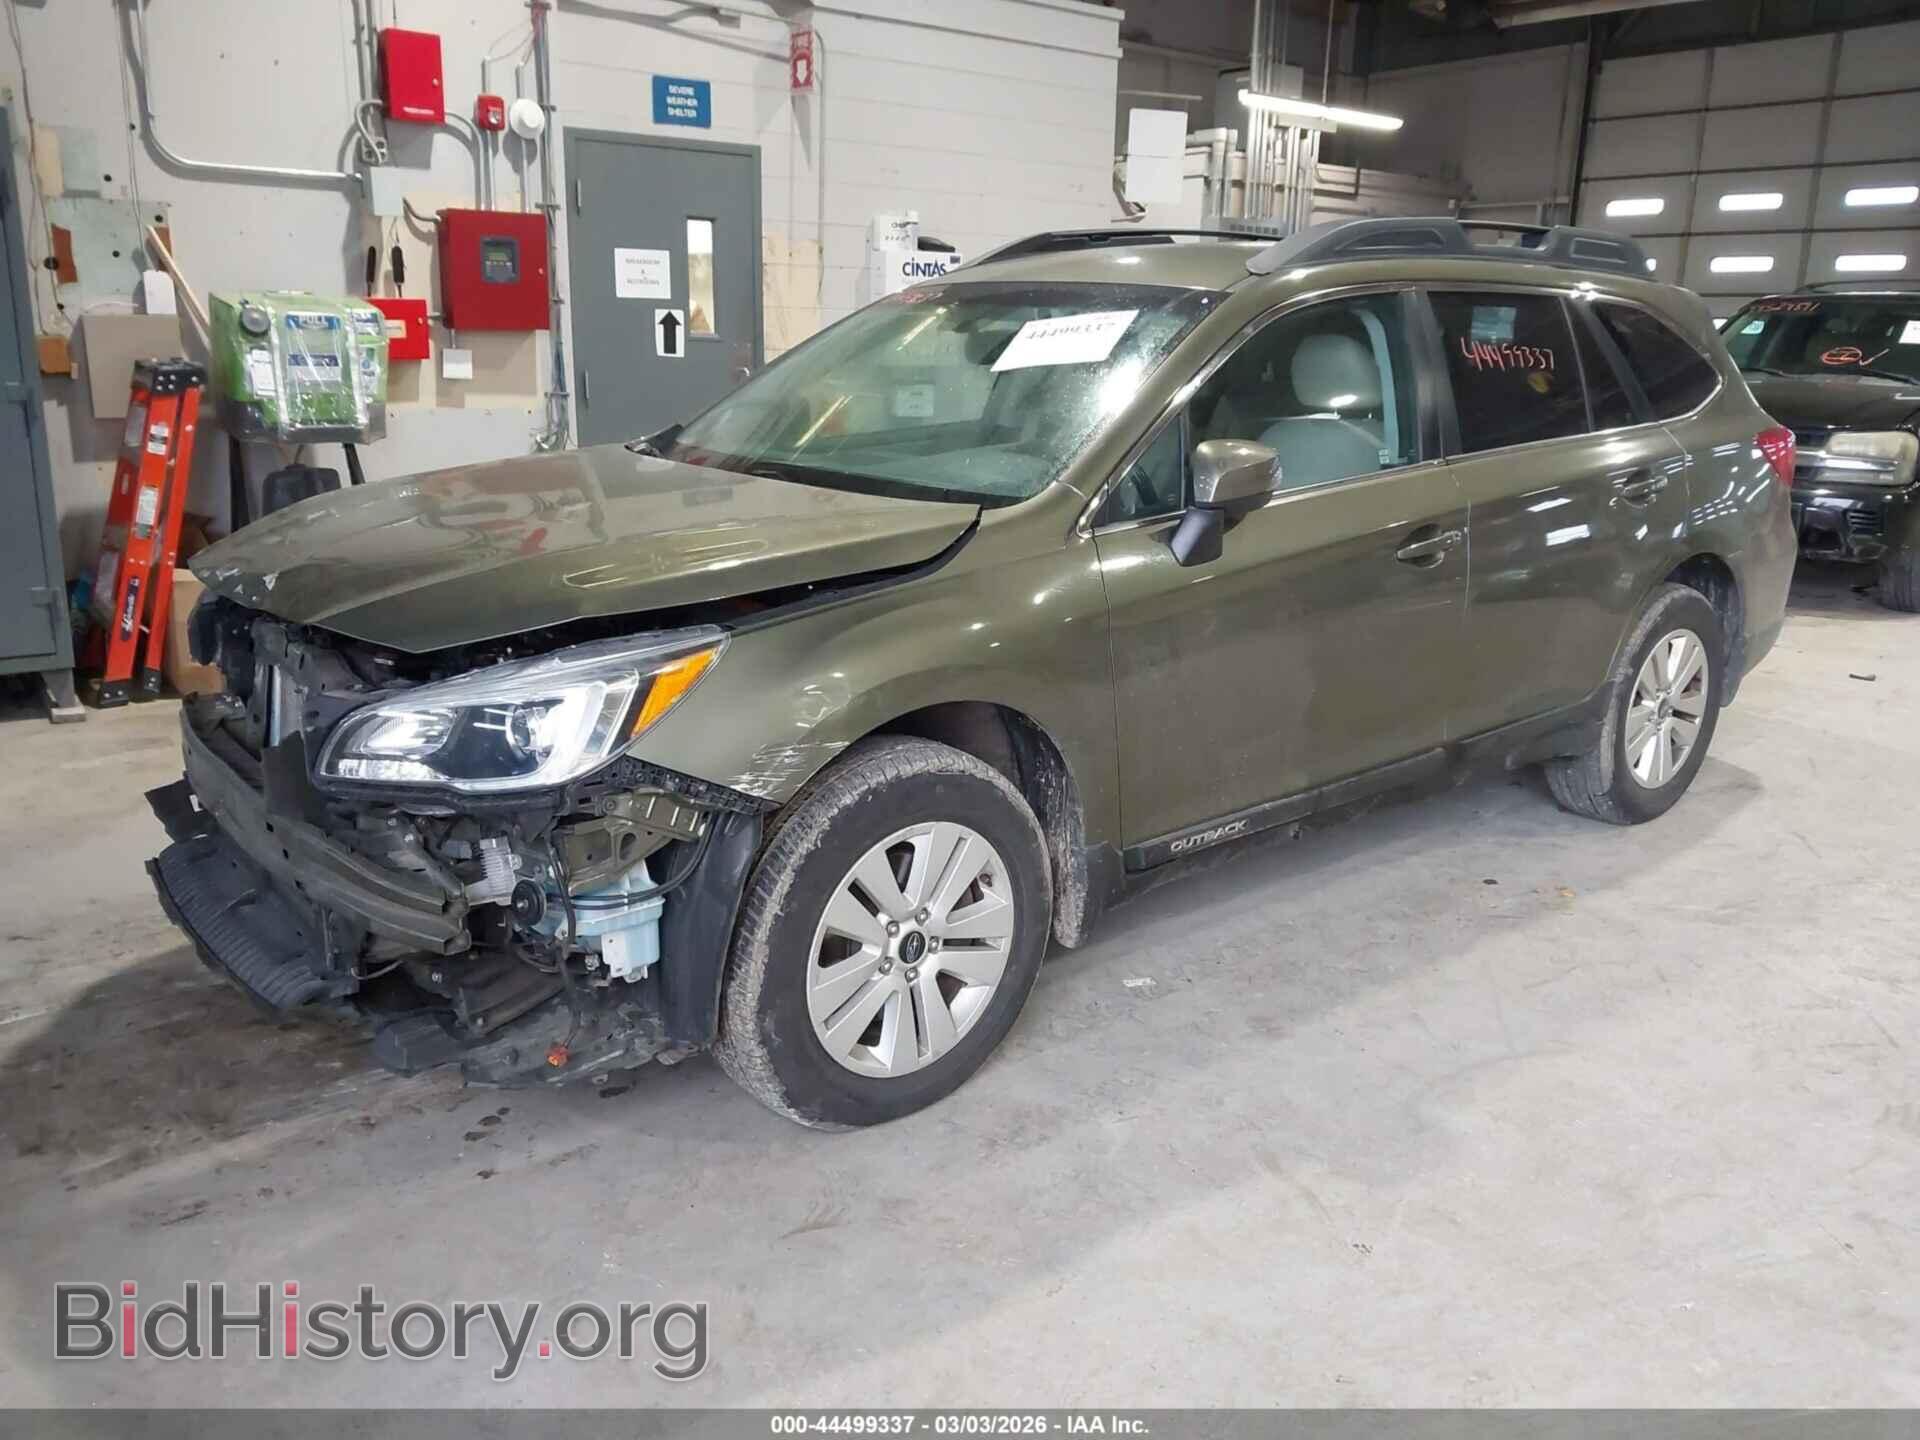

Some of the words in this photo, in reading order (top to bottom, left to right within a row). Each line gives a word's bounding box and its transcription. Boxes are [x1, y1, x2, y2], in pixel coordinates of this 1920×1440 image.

[668, 84, 695, 96] SEVERE
[666, 96, 698, 107] WEATHER
[667, 106, 697, 118] SHELTER
[1460, 336, 1555, 372] 44499337
[1170, 819, 1249, 852] OUTBACK
